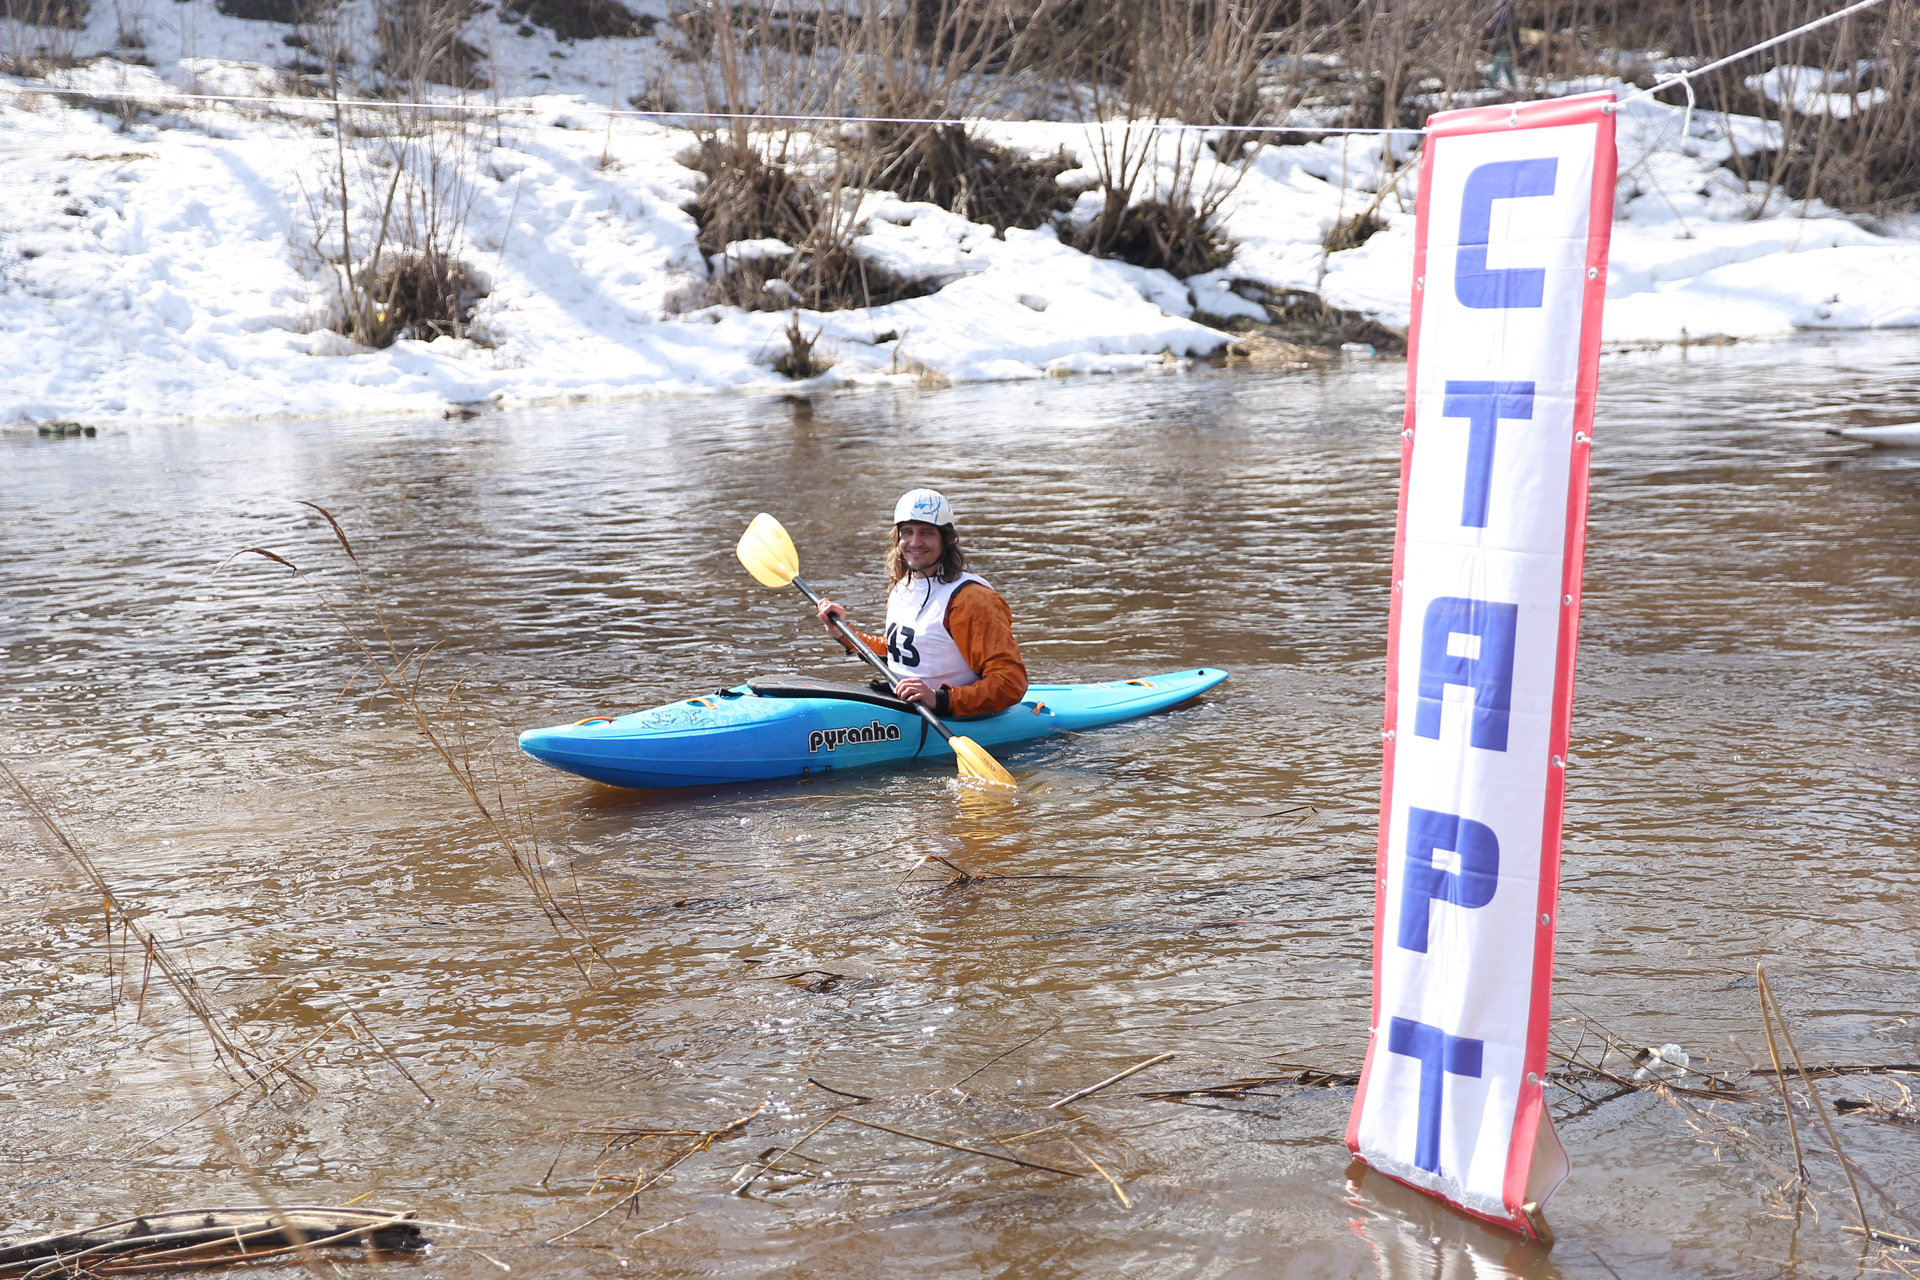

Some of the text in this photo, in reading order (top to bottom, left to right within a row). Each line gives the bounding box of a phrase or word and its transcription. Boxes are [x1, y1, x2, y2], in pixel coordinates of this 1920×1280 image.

[887, 622, 920, 667] 43
[1388, 157, 1558, 1176] СТАРТ
[808, 720, 901, 752] pyranha
